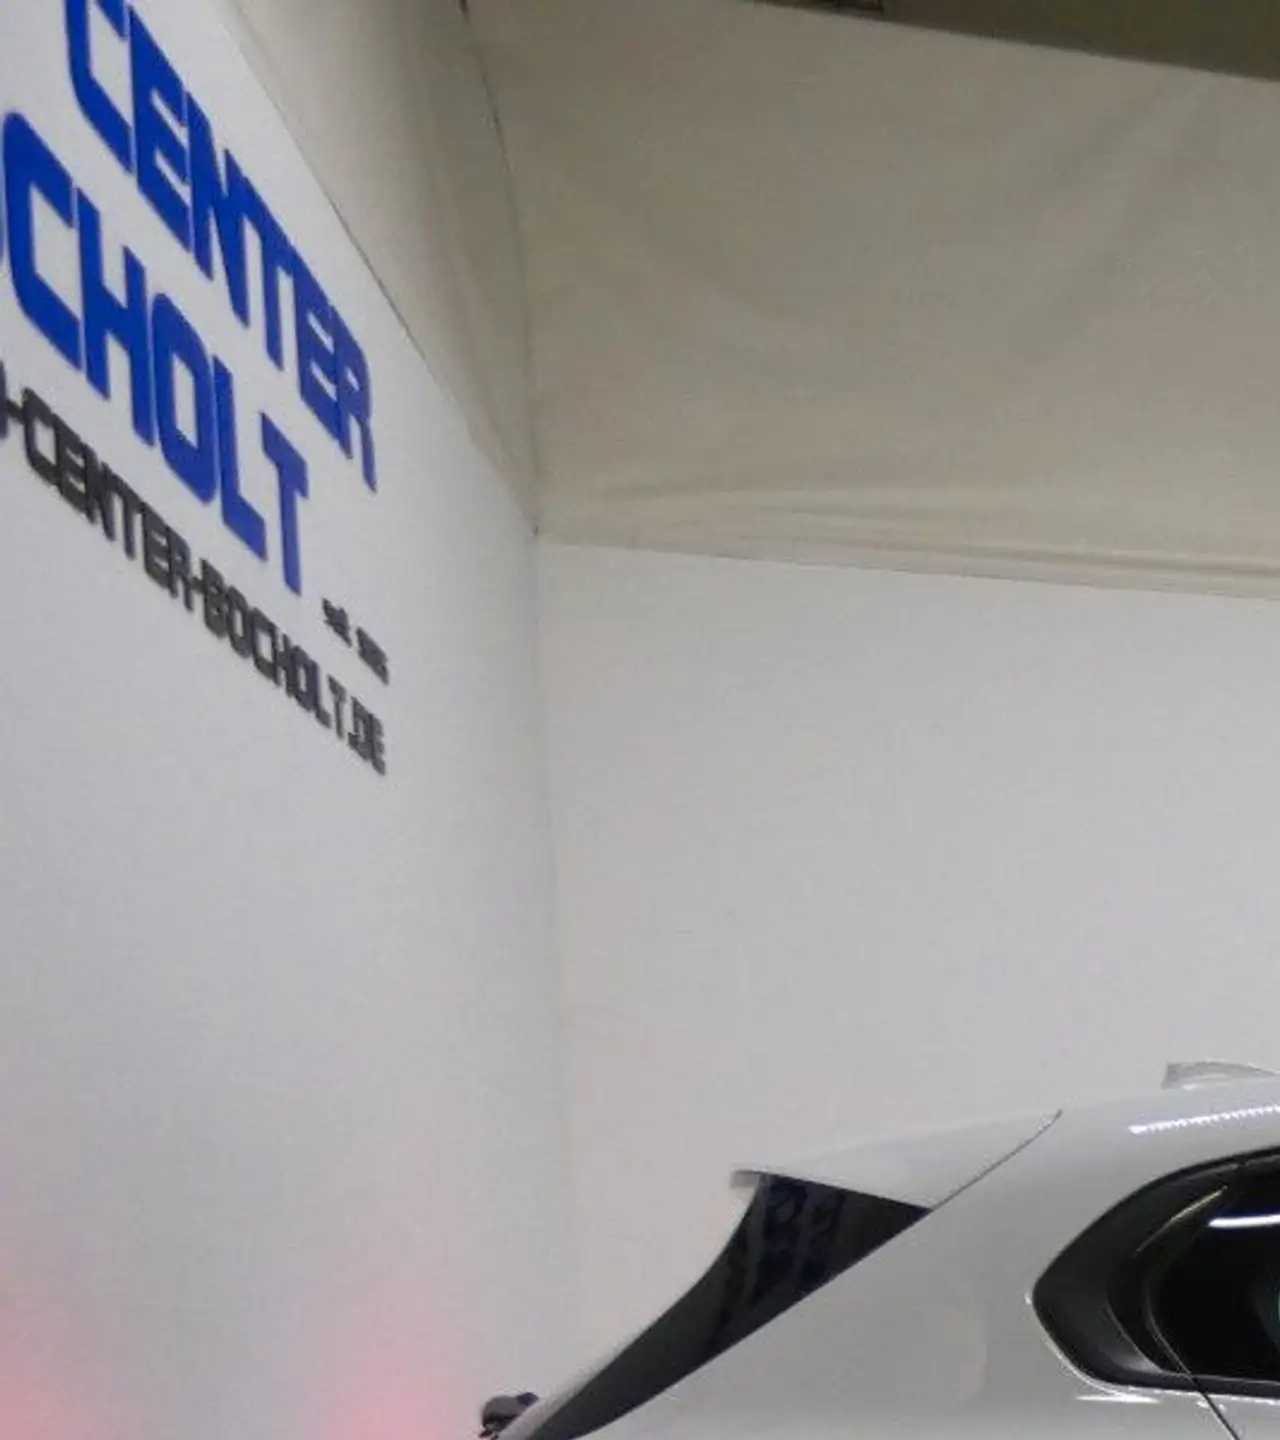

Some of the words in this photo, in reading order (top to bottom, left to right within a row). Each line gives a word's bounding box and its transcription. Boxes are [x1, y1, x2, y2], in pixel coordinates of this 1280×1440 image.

[0, 112, 309, 596] CHOLT
[64, 0, 376, 494] CENTER
[0, 360, 387, 776] -CENTER-BOCHOLT.DE
